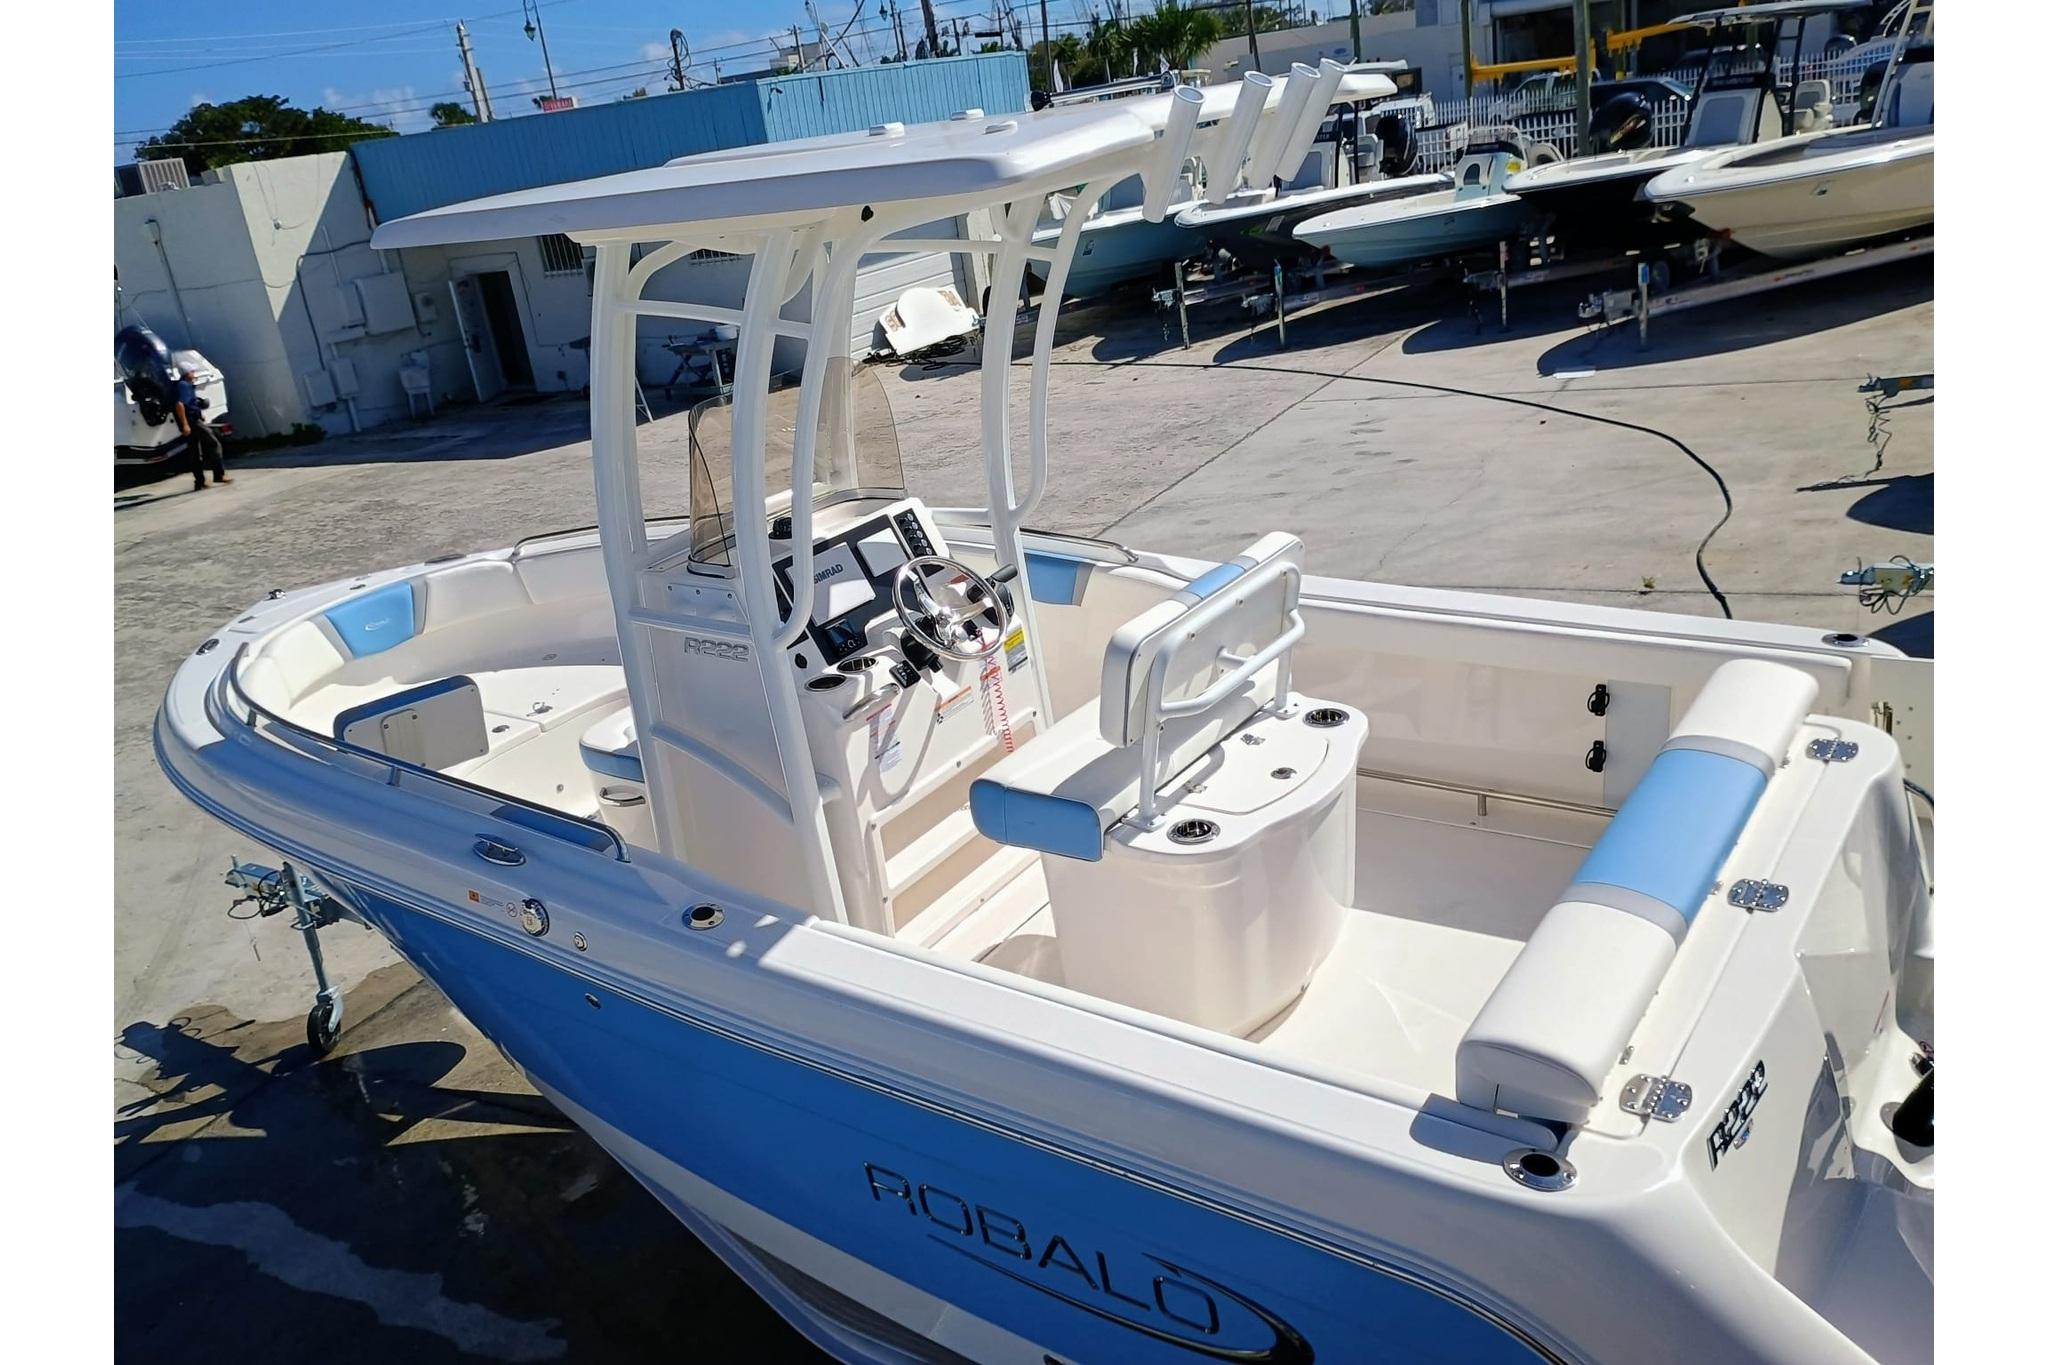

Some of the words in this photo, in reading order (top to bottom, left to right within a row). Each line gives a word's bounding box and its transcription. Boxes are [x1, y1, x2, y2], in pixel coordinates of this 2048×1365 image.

[684, 636, 749, 662] R222
[1706, 1059, 1768, 1171] R222
[863, 1161, 1220, 1334] ROBALO
